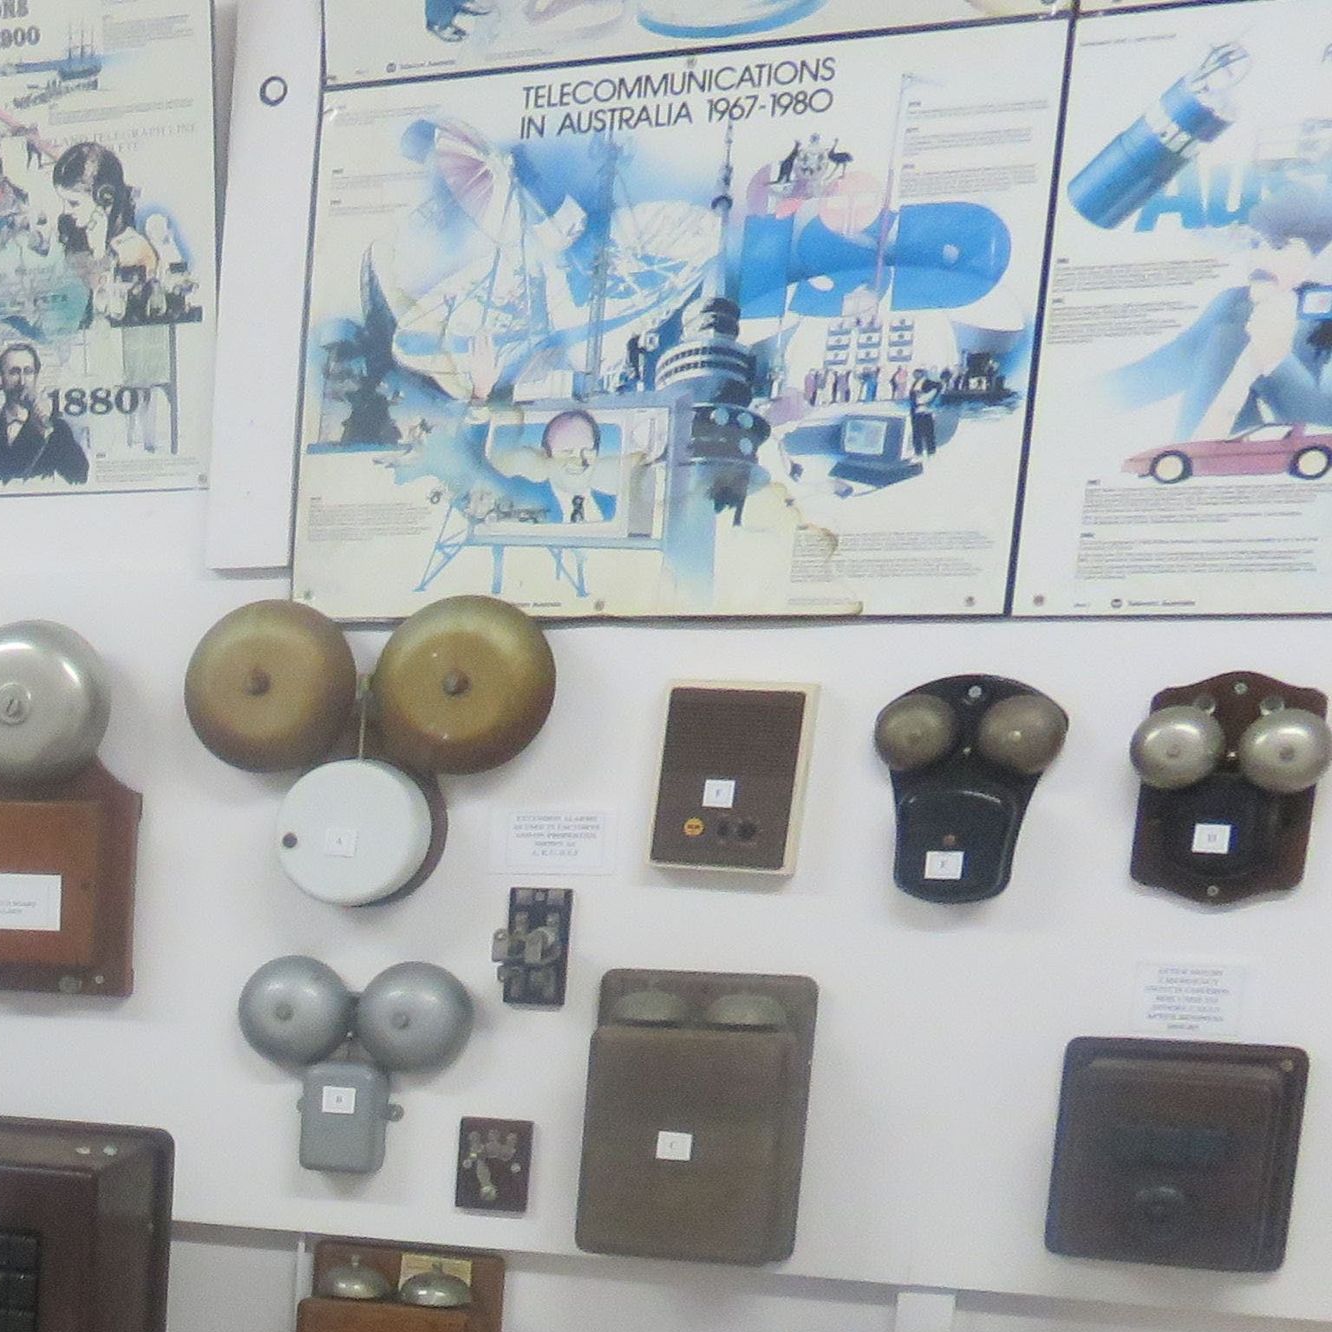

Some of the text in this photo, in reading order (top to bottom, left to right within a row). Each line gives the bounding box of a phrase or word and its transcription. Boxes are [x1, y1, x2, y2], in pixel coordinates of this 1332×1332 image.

[523, 57, 836, 109] TELECOMMUNICATIONS
[520, 89, 834, 139] IN AUSTRALIA 1967-1980
[47, 387, 139, 417] 1880
